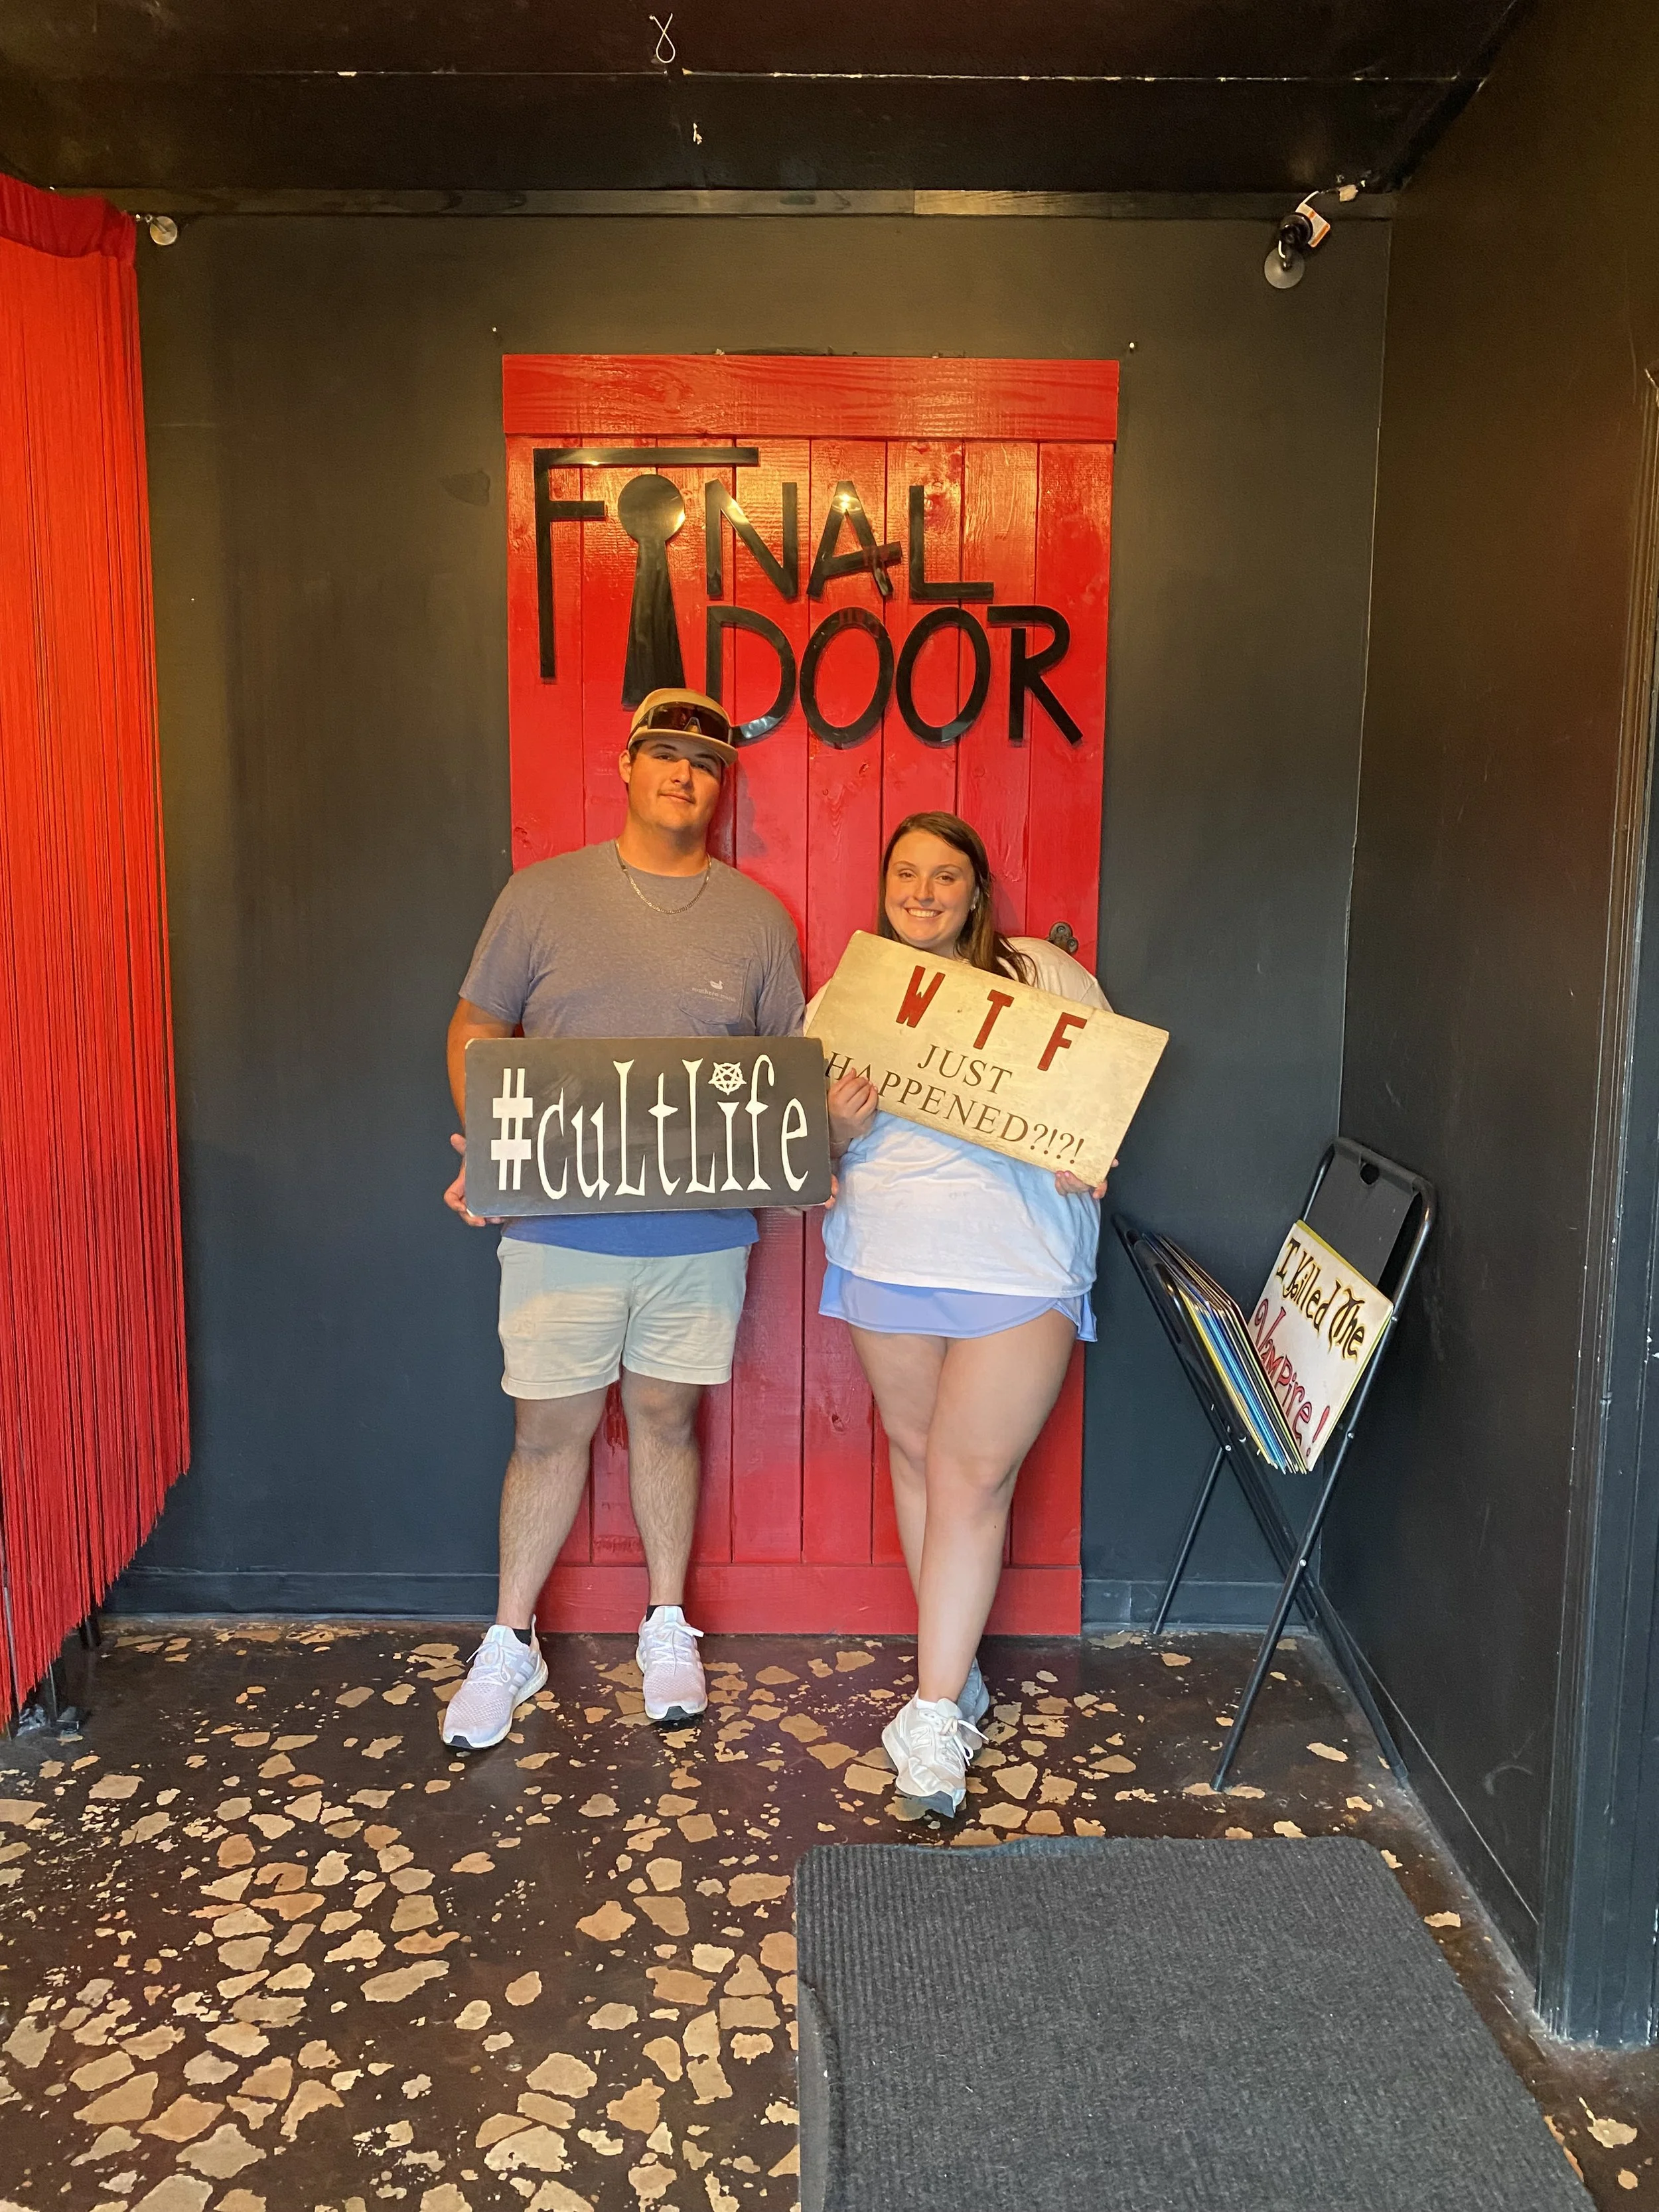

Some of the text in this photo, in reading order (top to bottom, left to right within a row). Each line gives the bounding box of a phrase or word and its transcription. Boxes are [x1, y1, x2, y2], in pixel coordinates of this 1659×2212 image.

[533, 447, 994, 710] FINAL
[706, 605, 1083, 745] DOOR
[824, 1051, 1084, 1164] HAPPENED?!?!
[917, 1044, 1012, 1094] JUST
[1275, 1237, 1301, 1283] I
[1328, 1287, 1366, 1361] The
